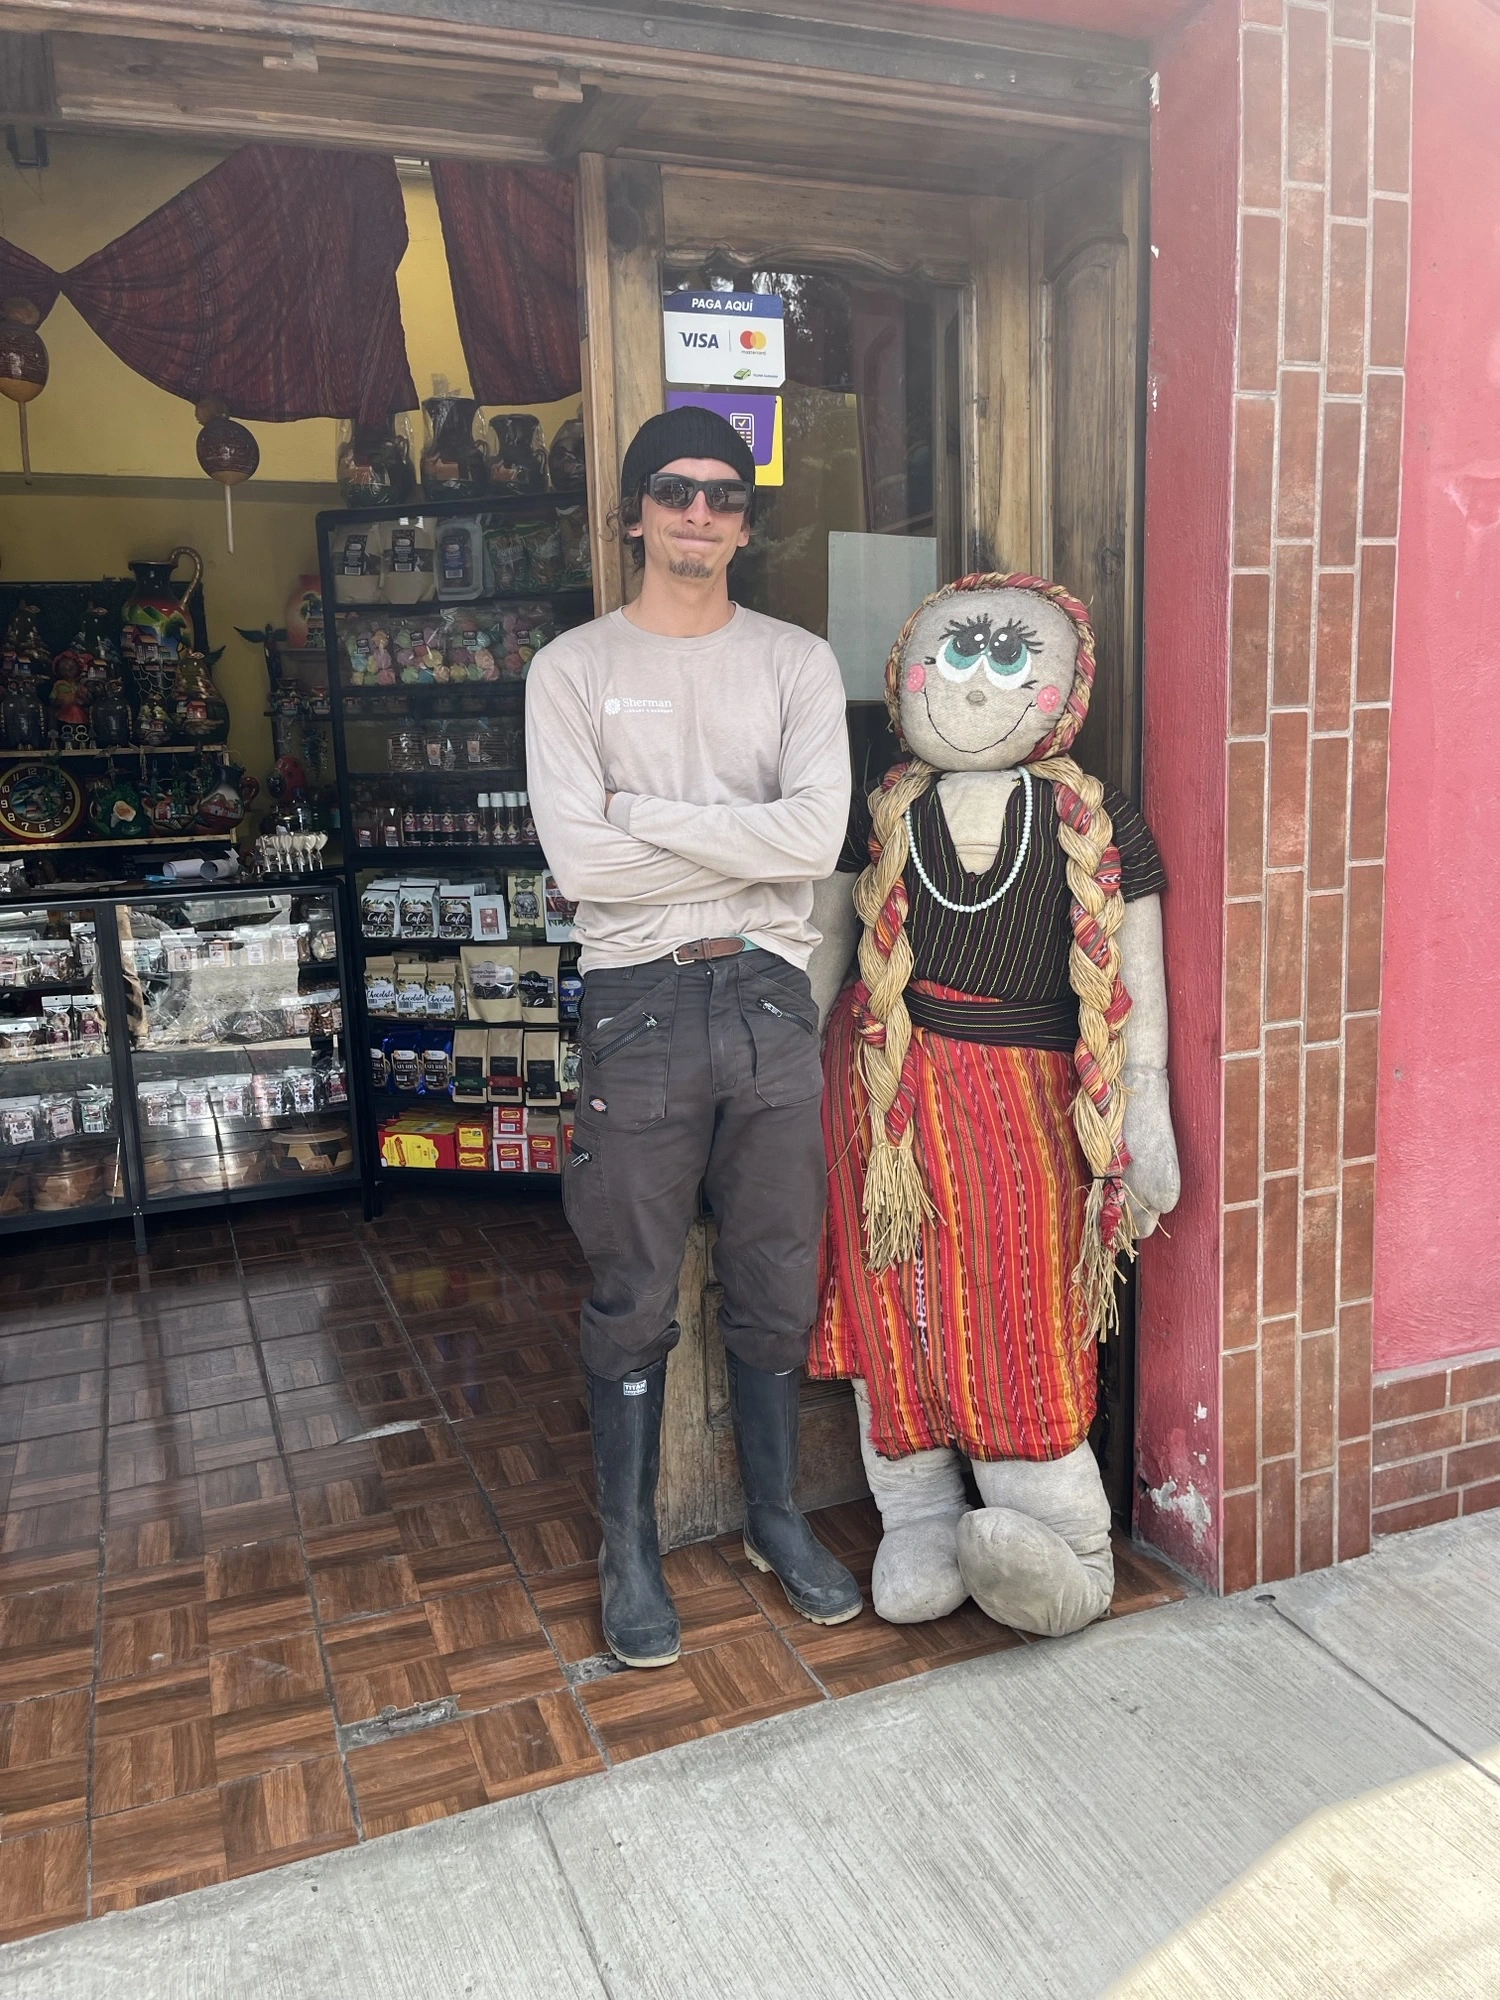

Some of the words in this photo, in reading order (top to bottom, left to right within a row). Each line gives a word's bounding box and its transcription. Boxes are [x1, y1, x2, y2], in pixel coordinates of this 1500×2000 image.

[691, 298, 722, 310] PAGA
[724, 299, 754, 312] AQUÍ
[678, 331, 719, 349] VISA
[622, 697, 672, 708] Sherman
[27, 767, 37, 775] 12
[13, 773, 20, 782] 11
[2, 785, 10, 794] 10
[65, 791, 73, 800] 3
[0, 799, 8, 809] 9
[63, 805, 71, 815] 4
[7, 812, 16, 822] 8
[21, 822, 29, 831] 7
[54, 817, 61, 827] 5
[38, 823, 47, 832] 6
[366, 989, 394, 999] Chocolate
[397, 993, 425, 1002] Chocolate
[427, 994, 455, 1003] Chocolate
[624, 1382, 646, 1391] TITAN
